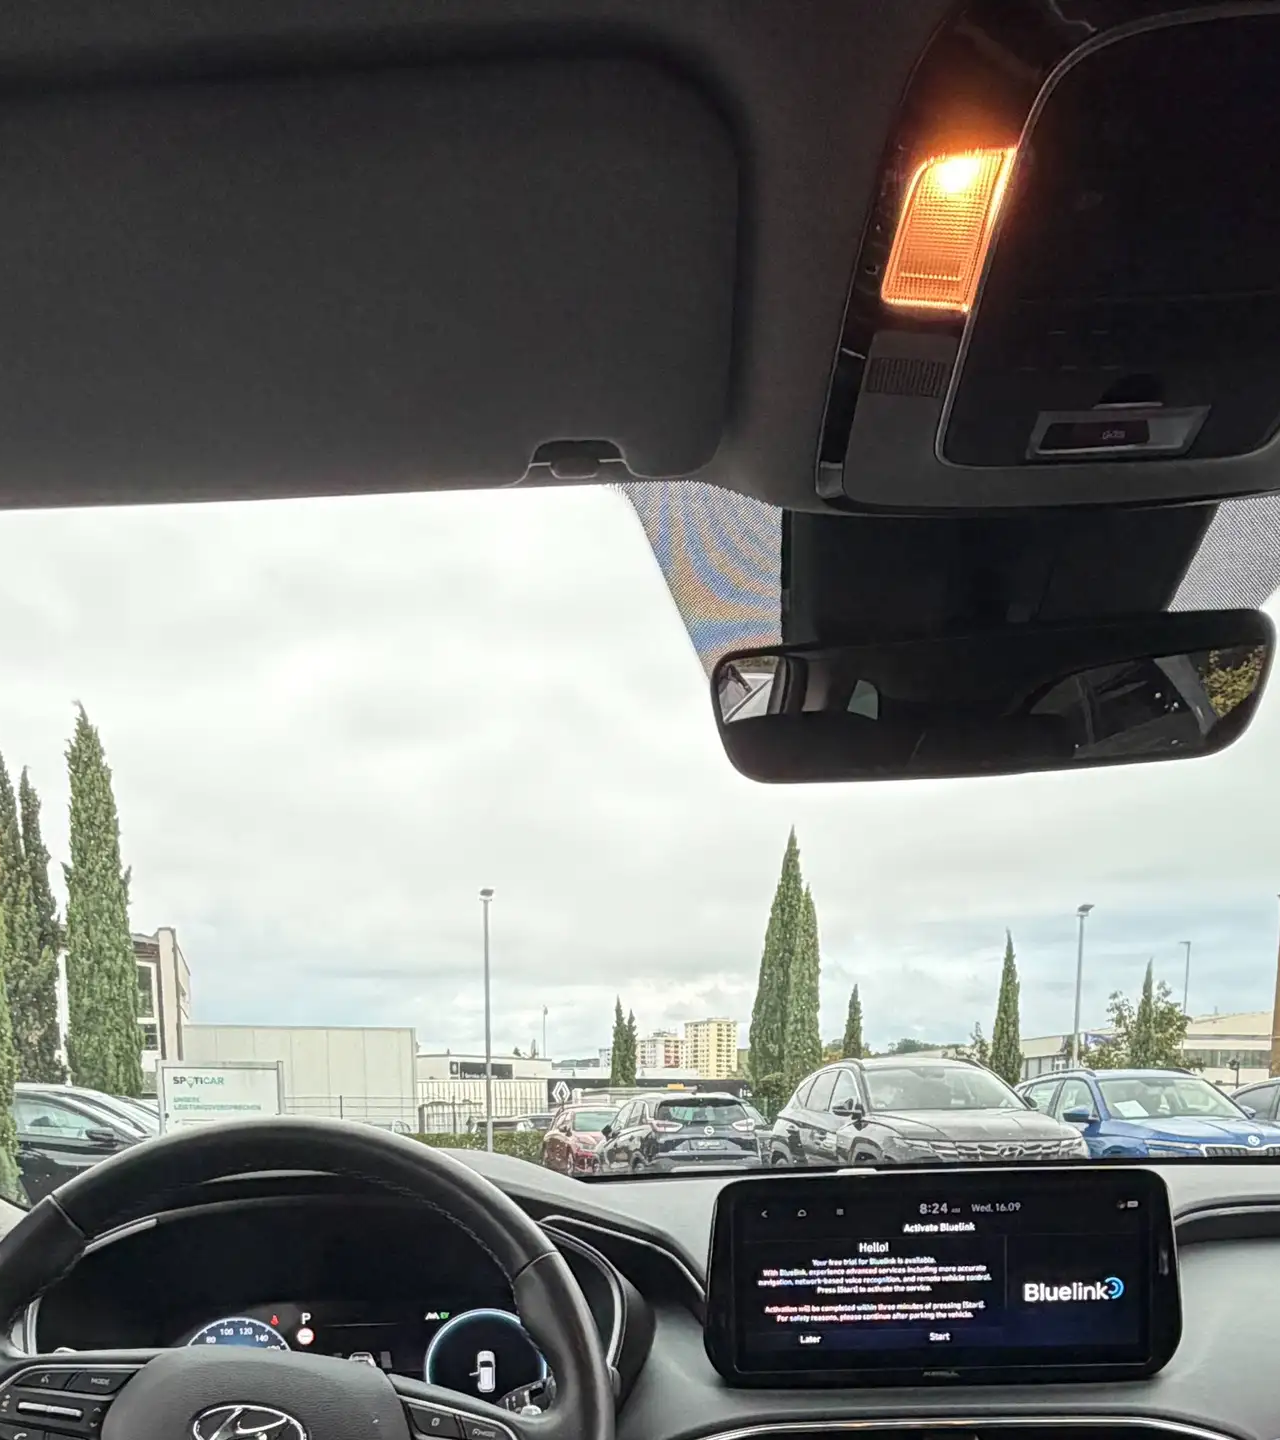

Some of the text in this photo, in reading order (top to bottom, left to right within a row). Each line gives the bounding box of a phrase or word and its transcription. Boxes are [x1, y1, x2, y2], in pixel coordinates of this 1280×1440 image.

[173, 1076, 224, 1088] SPOTICAR
[919, 1203, 948, 1214] 8:24
[995, 1202, 1021, 1212] 16.09
[903, 1222, 976, 1233] Activate Bluelink
[859, 1242, 889, 1253] Hello!
[812, 1259, 827, 1267] Your
[843, 1258, 857, 1266] trial
[858, 1258, 868, 1266] for
[897, 1257, 904, 1265] is
[763, 1269, 778, 1277] With
[808, 1268, 845, 1277] experience
[846, 1267, 877, 1275] advanced
[878, 1267, 906, 1275] services
[907, 1266, 938, 1275] including
[957, 1265, 987, 1273] accurate
[795, 1277, 844, 1286] network-based
[845, 1277, 862, 1285] voice
[917, 1275, 941, 1283] remote
[941, 1274, 966, 1282] vehicle
[817, 1286, 836, 1294] Press
[867, 1285, 893, 1293] activate
[1024, 1282, 1110, 1302] Bluelink
[812, 1304, 820, 1312] be
[925, 1302, 932, 1310] of
[932, 1302, 962, 1311] pressing
[301, 1312, 312, 1325] P
[777, 1315, 788, 1323] For
[909, 1312, 936, 1321] parking
[936, 1311, 947, 1319] the
[220, 1327, 253, 1336] 100 120
[929, 1332, 951, 1341] Start
[205, 1336, 217, 1344] 80
[255, 1335, 269, 1343] 140
[800, 1335, 821, 1344] Later
